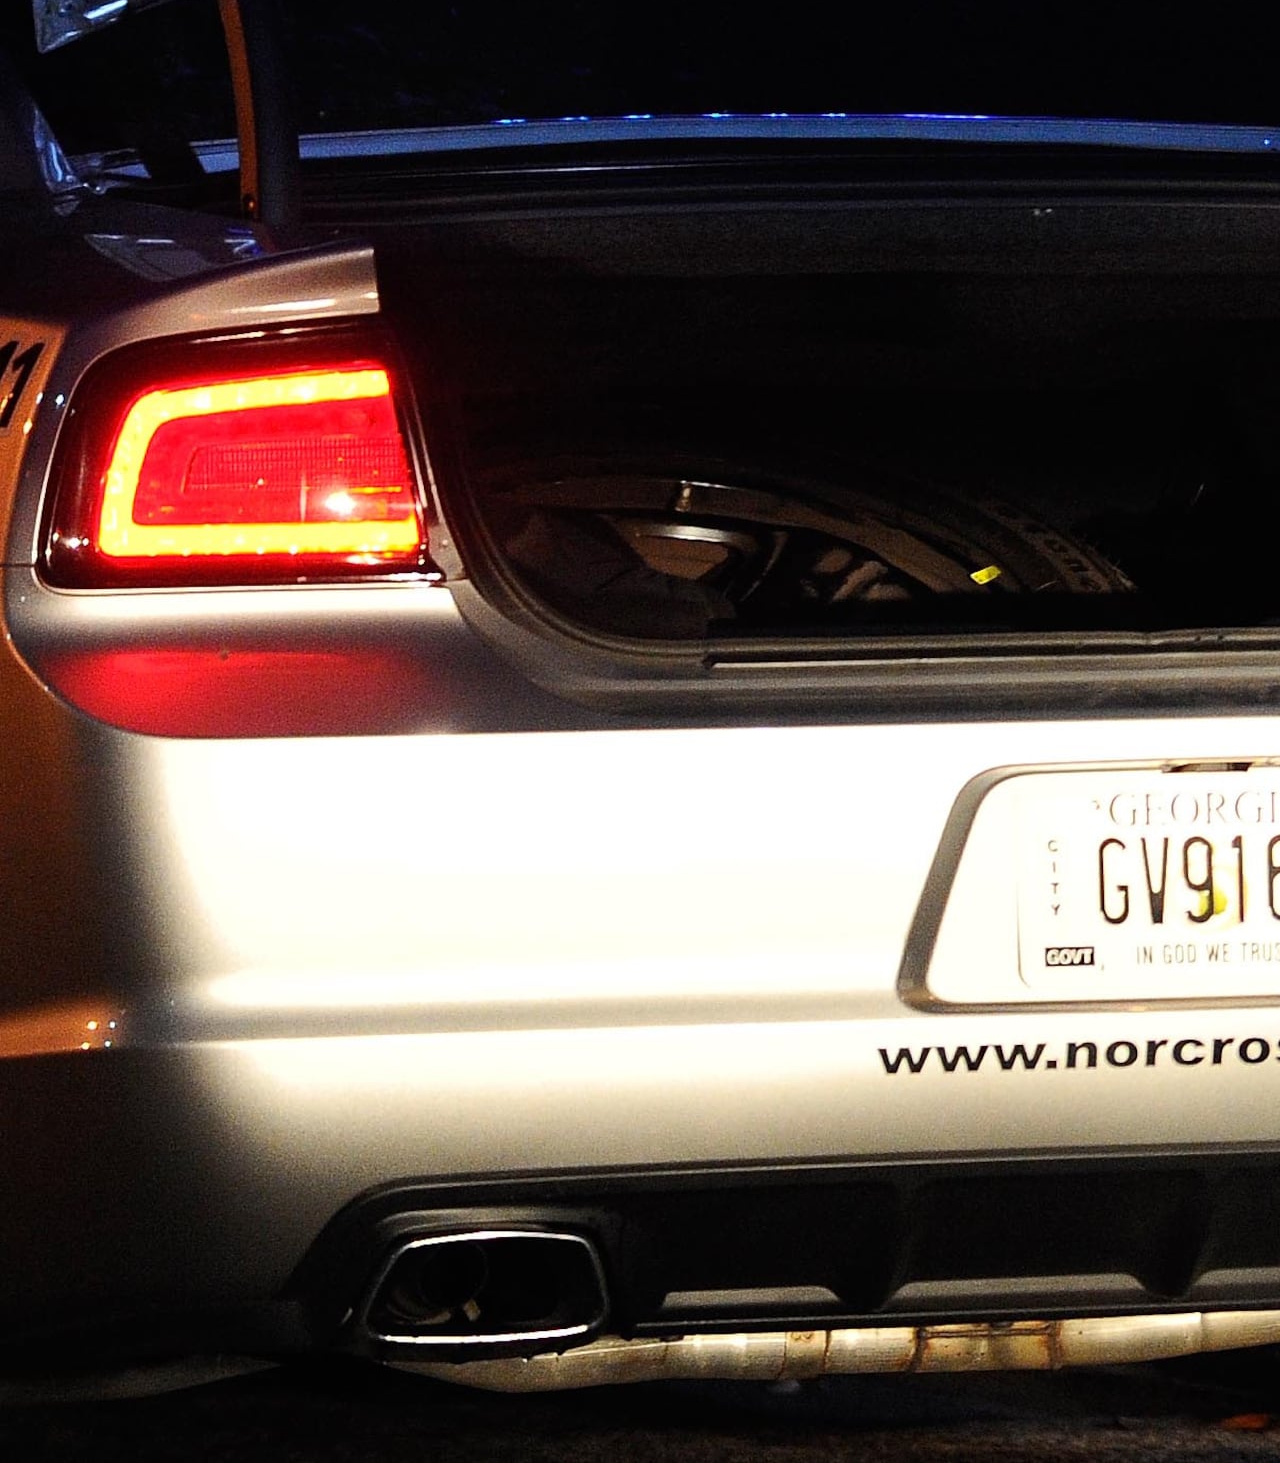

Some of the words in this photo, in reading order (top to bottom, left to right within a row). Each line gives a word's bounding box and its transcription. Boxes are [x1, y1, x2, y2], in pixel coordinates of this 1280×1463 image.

[1047, 839, 1061, 917] CITY
[1046, 948, 1093, 966] GOVT
[1136, 945, 1153, 964] IN
[1163, 944, 1197, 964] GOD
[1208, 943, 1230, 963] WE
